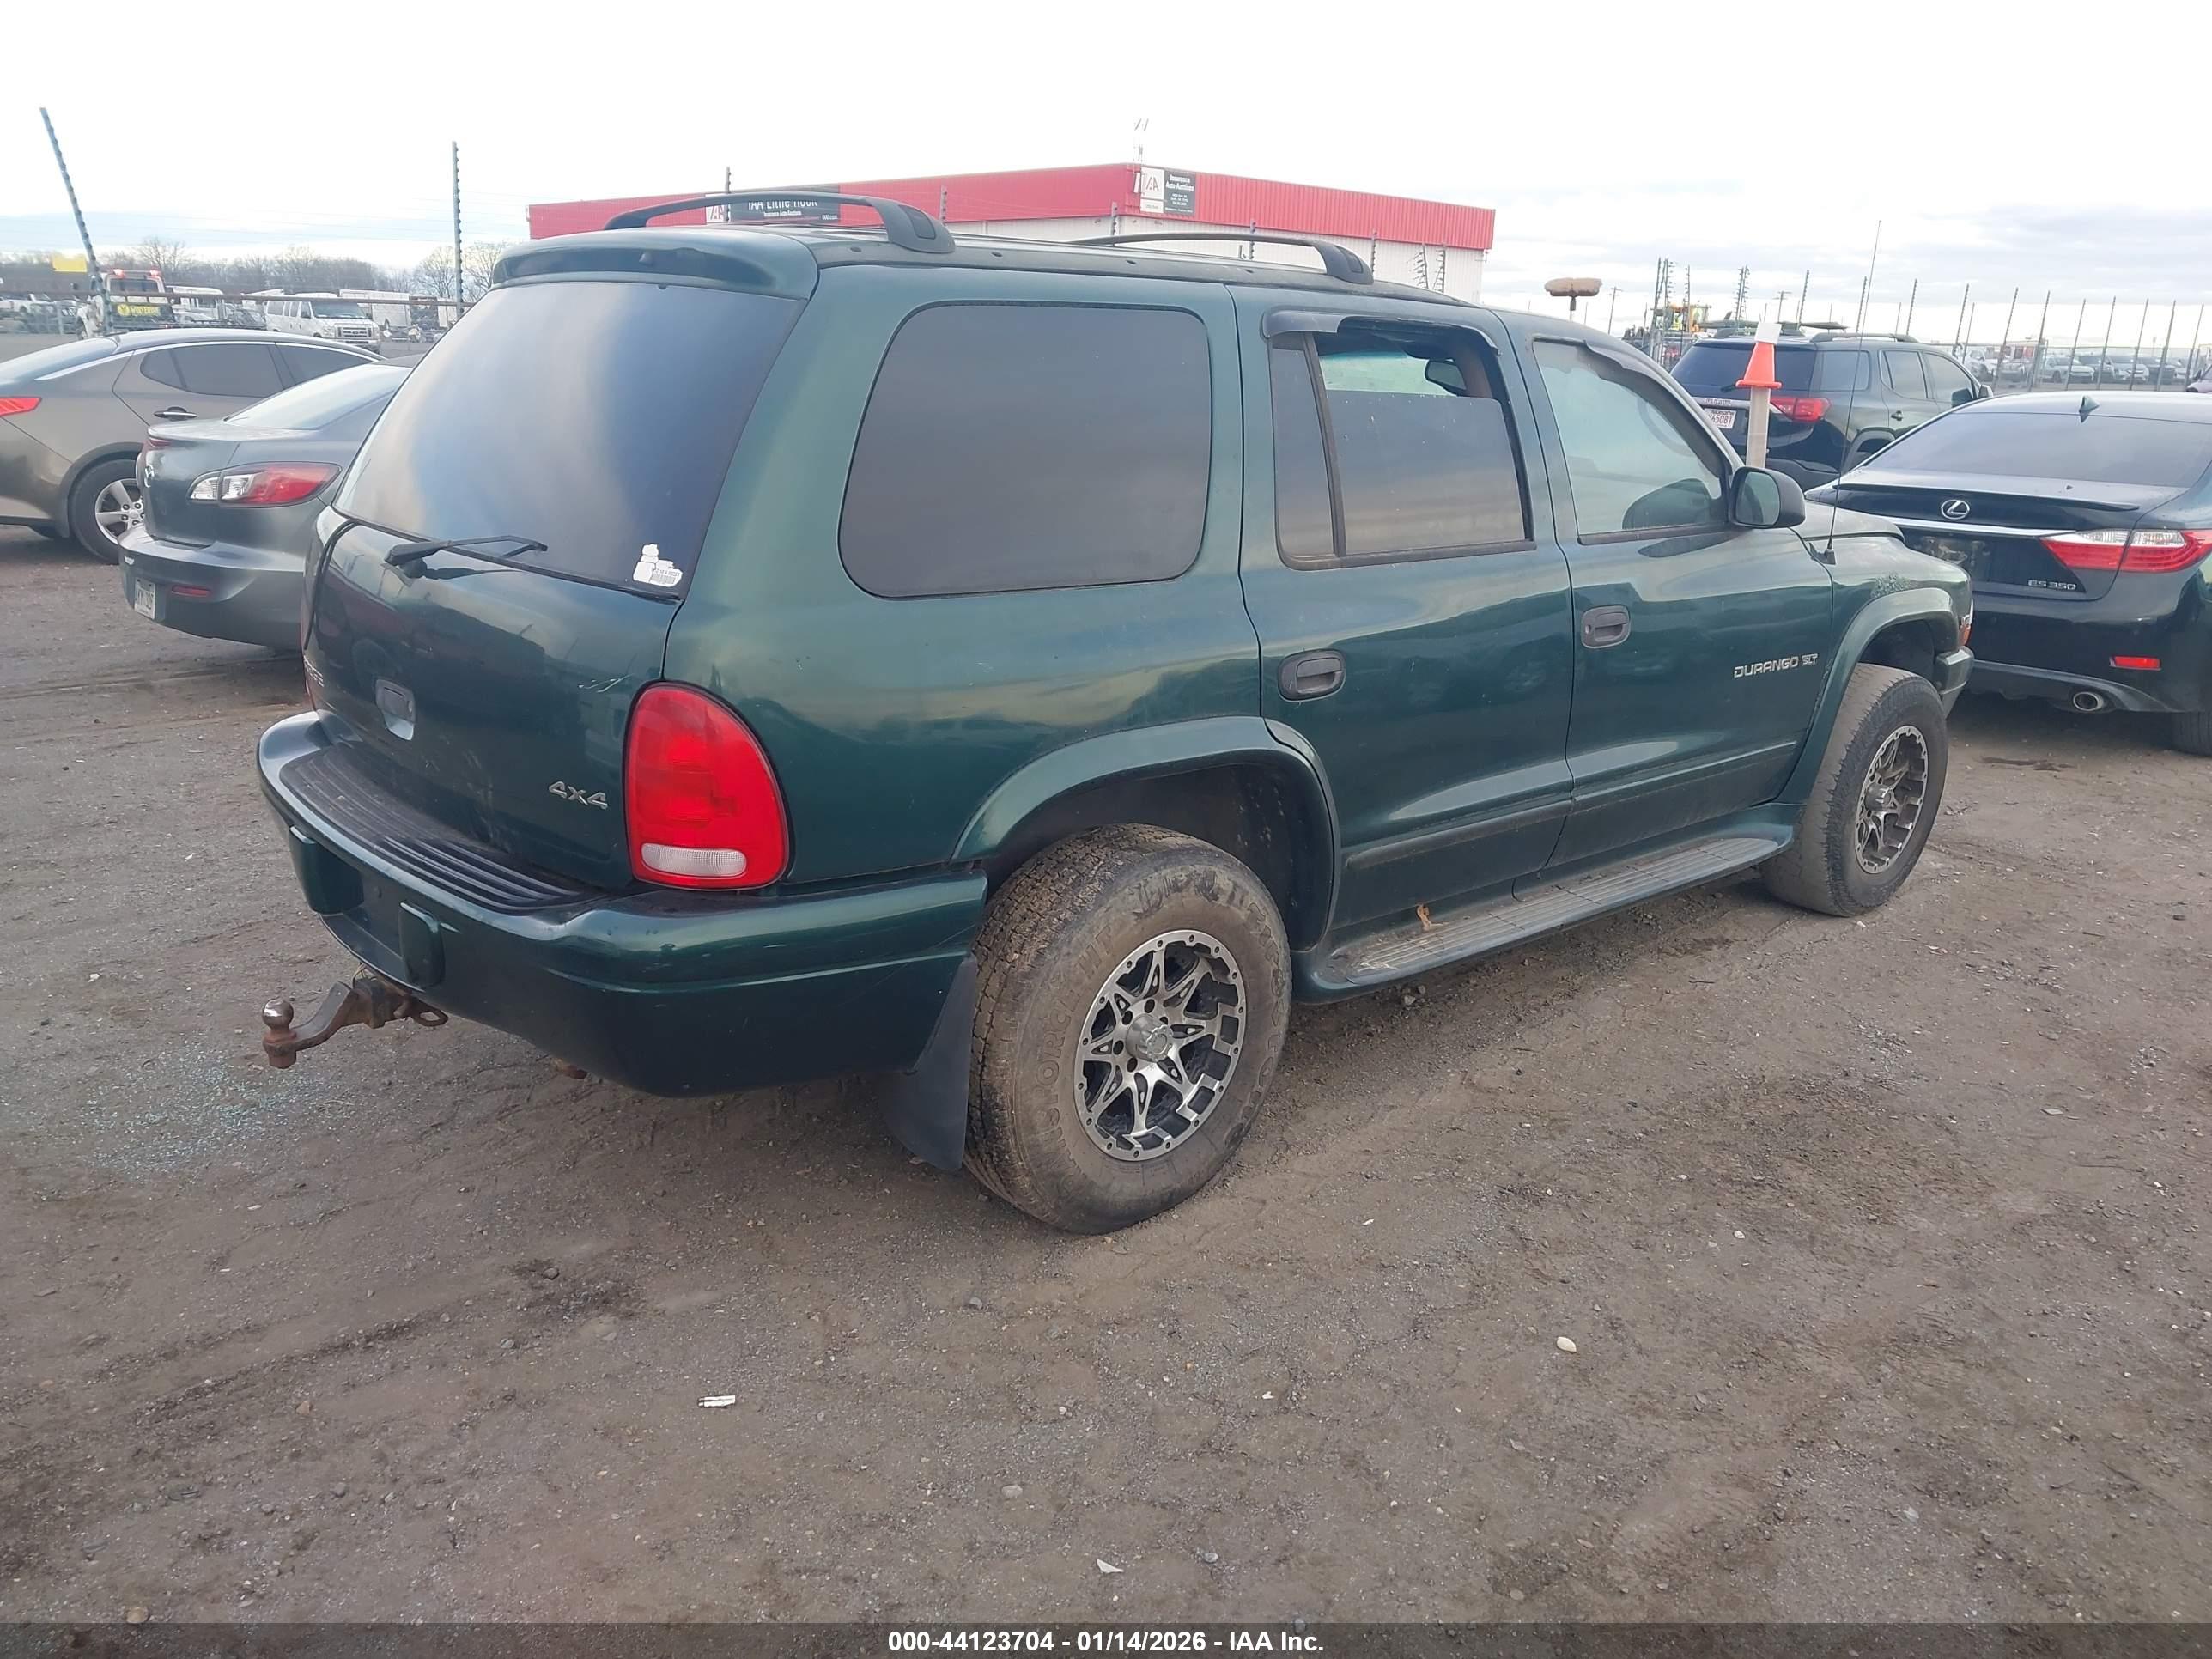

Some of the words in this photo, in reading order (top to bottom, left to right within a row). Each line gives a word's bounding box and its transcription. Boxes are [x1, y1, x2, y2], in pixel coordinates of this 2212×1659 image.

[2028, 580, 2047, 588] ES
[2048, 581, 2076, 591] 350
[1734, 656, 1799, 678] DURANGO
[1802, 653, 1819, 666] SLT
